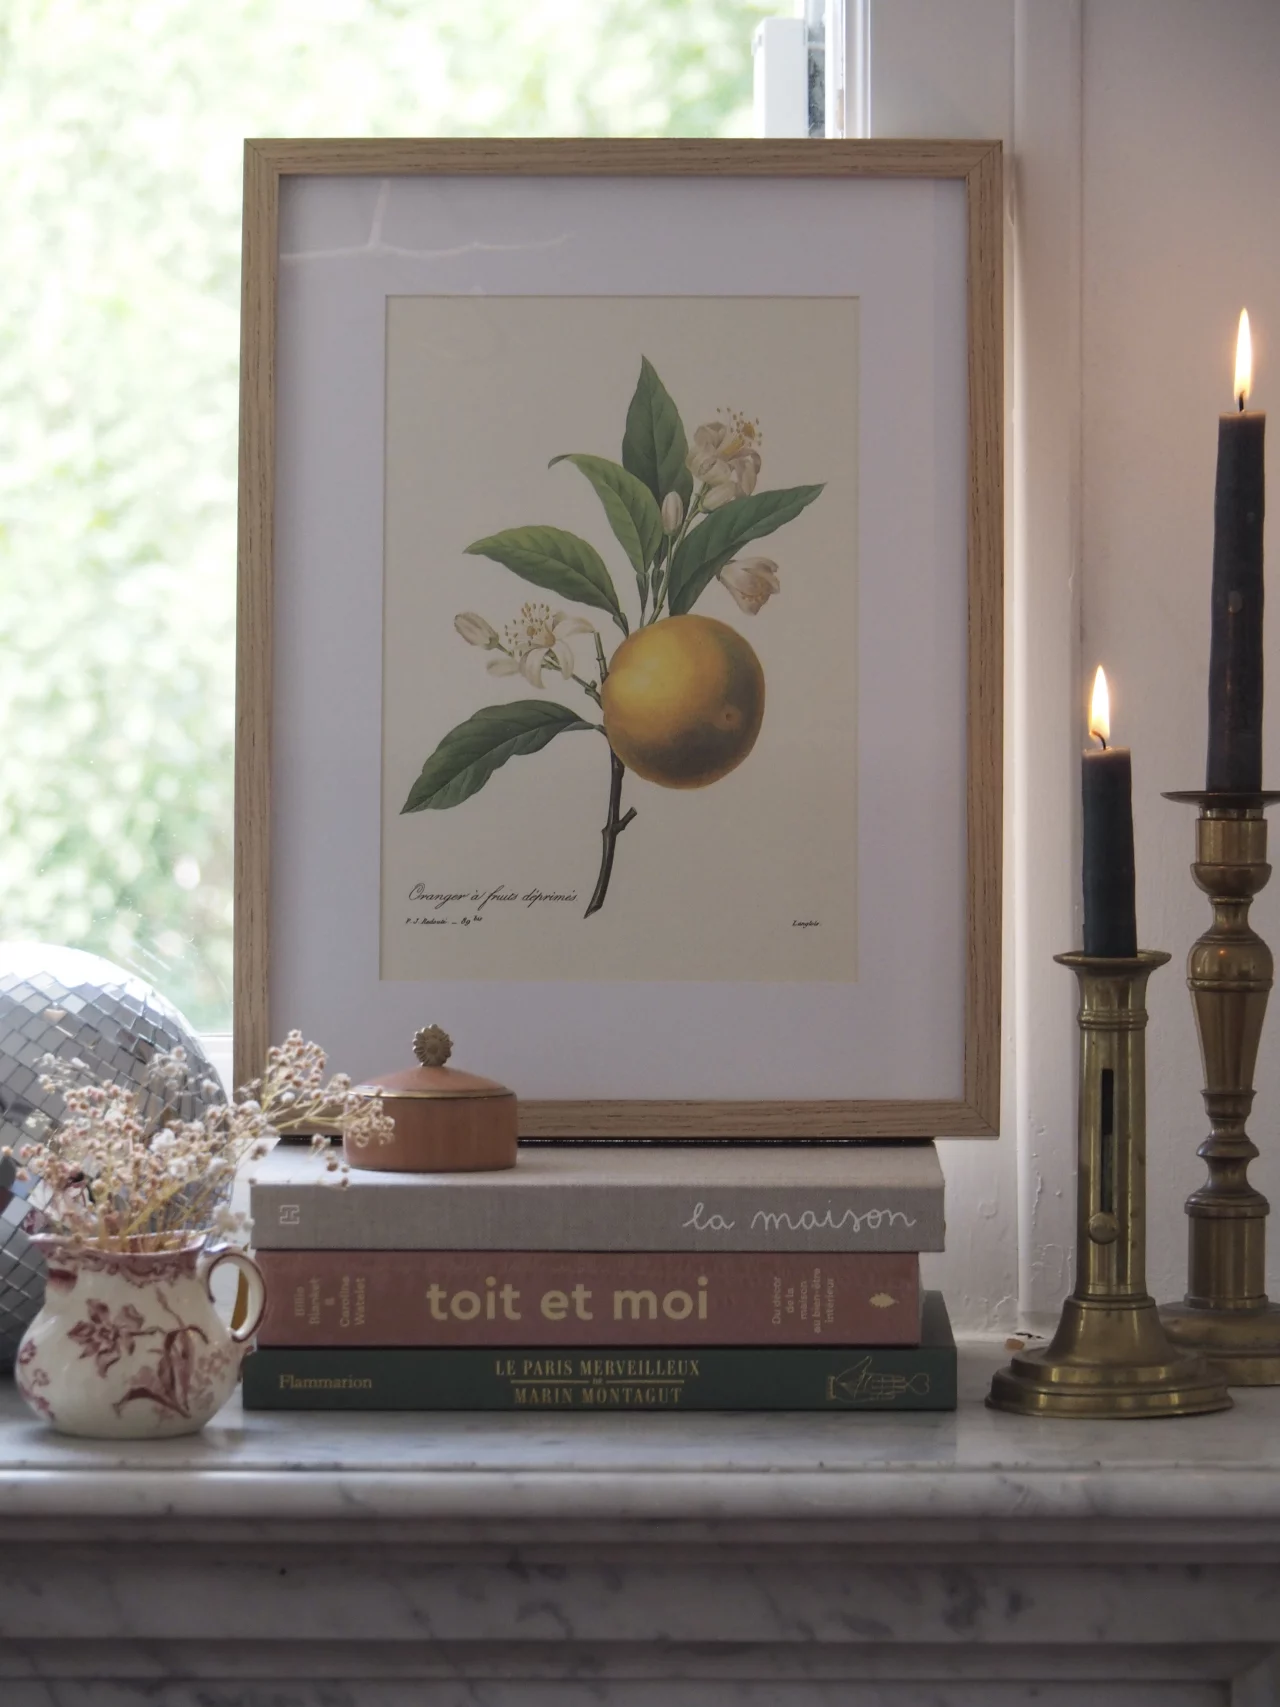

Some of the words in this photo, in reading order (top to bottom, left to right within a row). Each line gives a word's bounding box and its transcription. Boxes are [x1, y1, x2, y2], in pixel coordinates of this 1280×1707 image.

[408, 882, 467, 909] Oranger
[477, 885, 518, 911] fruits
[682, 1202, 735, 1230] la
[751, 1200, 917, 1232] maison
[426, 1276, 522, 1320] toit
[540, 1283, 594, 1320] et
[613, 1276, 709, 1320] moi
[785, 1287, 794, 1298] la
[798, 1280, 807, 1320] maison
[340, 1276, 350, 1328] Caroline
[354, 1278, 365, 1326] Watelet
[786, 1300, 794, 1313] de
[771, 1309, 781, 1325] Du
[814, 1320, 821, 1334] au
[495, 1360, 516, 1376] LE
[523, 1359, 573, 1376] PARIS
[580, 1359, 700, 1376] MERVEILLEUX
[279, 1373, 373, 1390] Flammarion
[514, 1388, 573, 1404] MARIN
[582, 1387, 682, 1404] MONTAGUT
